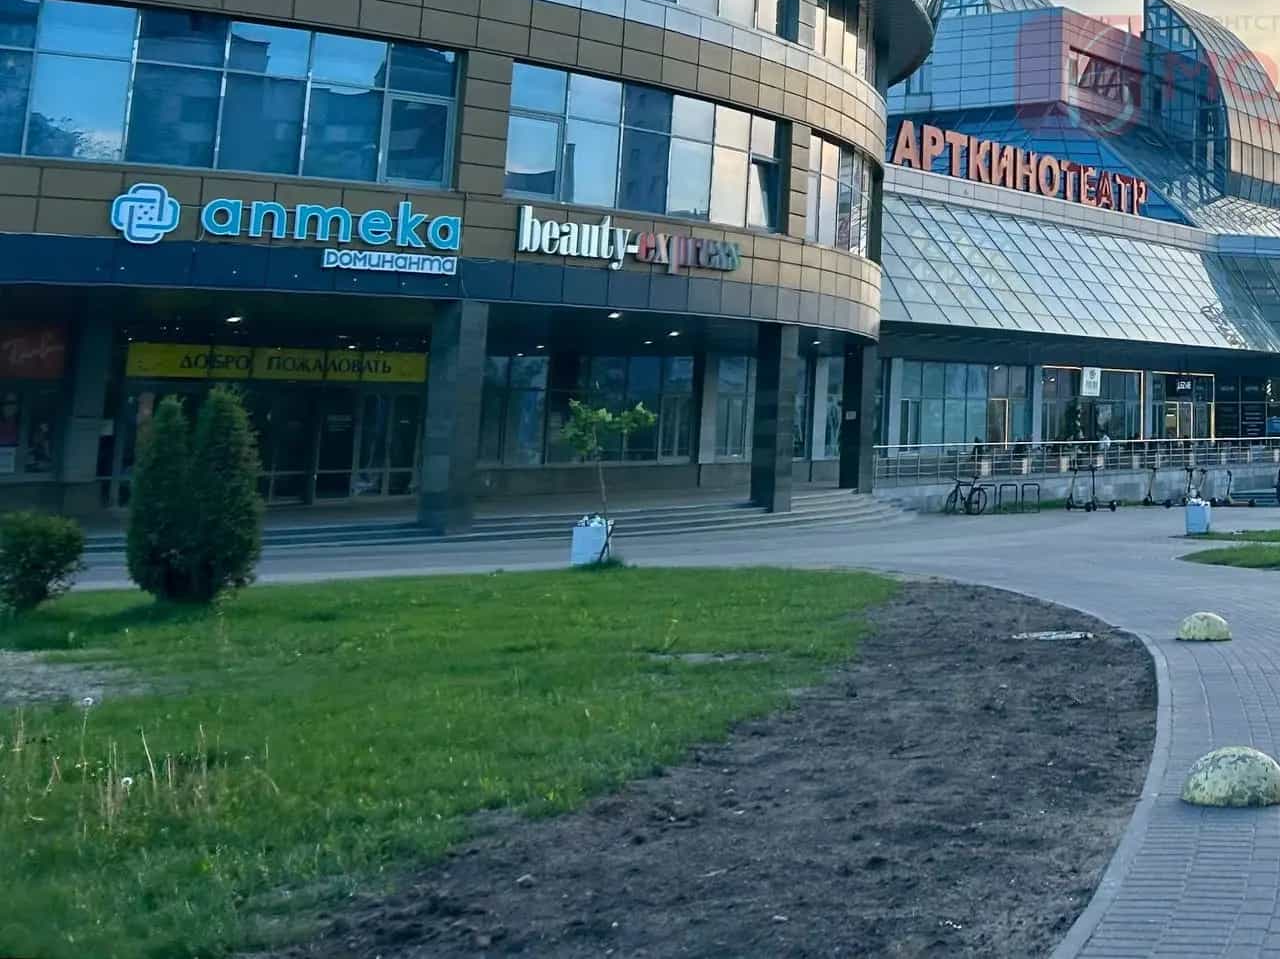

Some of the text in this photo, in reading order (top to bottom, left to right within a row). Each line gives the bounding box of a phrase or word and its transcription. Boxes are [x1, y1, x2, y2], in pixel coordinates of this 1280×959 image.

[891, 119, 1148, 216] АРТКИНОТЕАТР
[518, 205, 742, 274] beauty-express
[179, 353, 250, 371] ДОБРО
